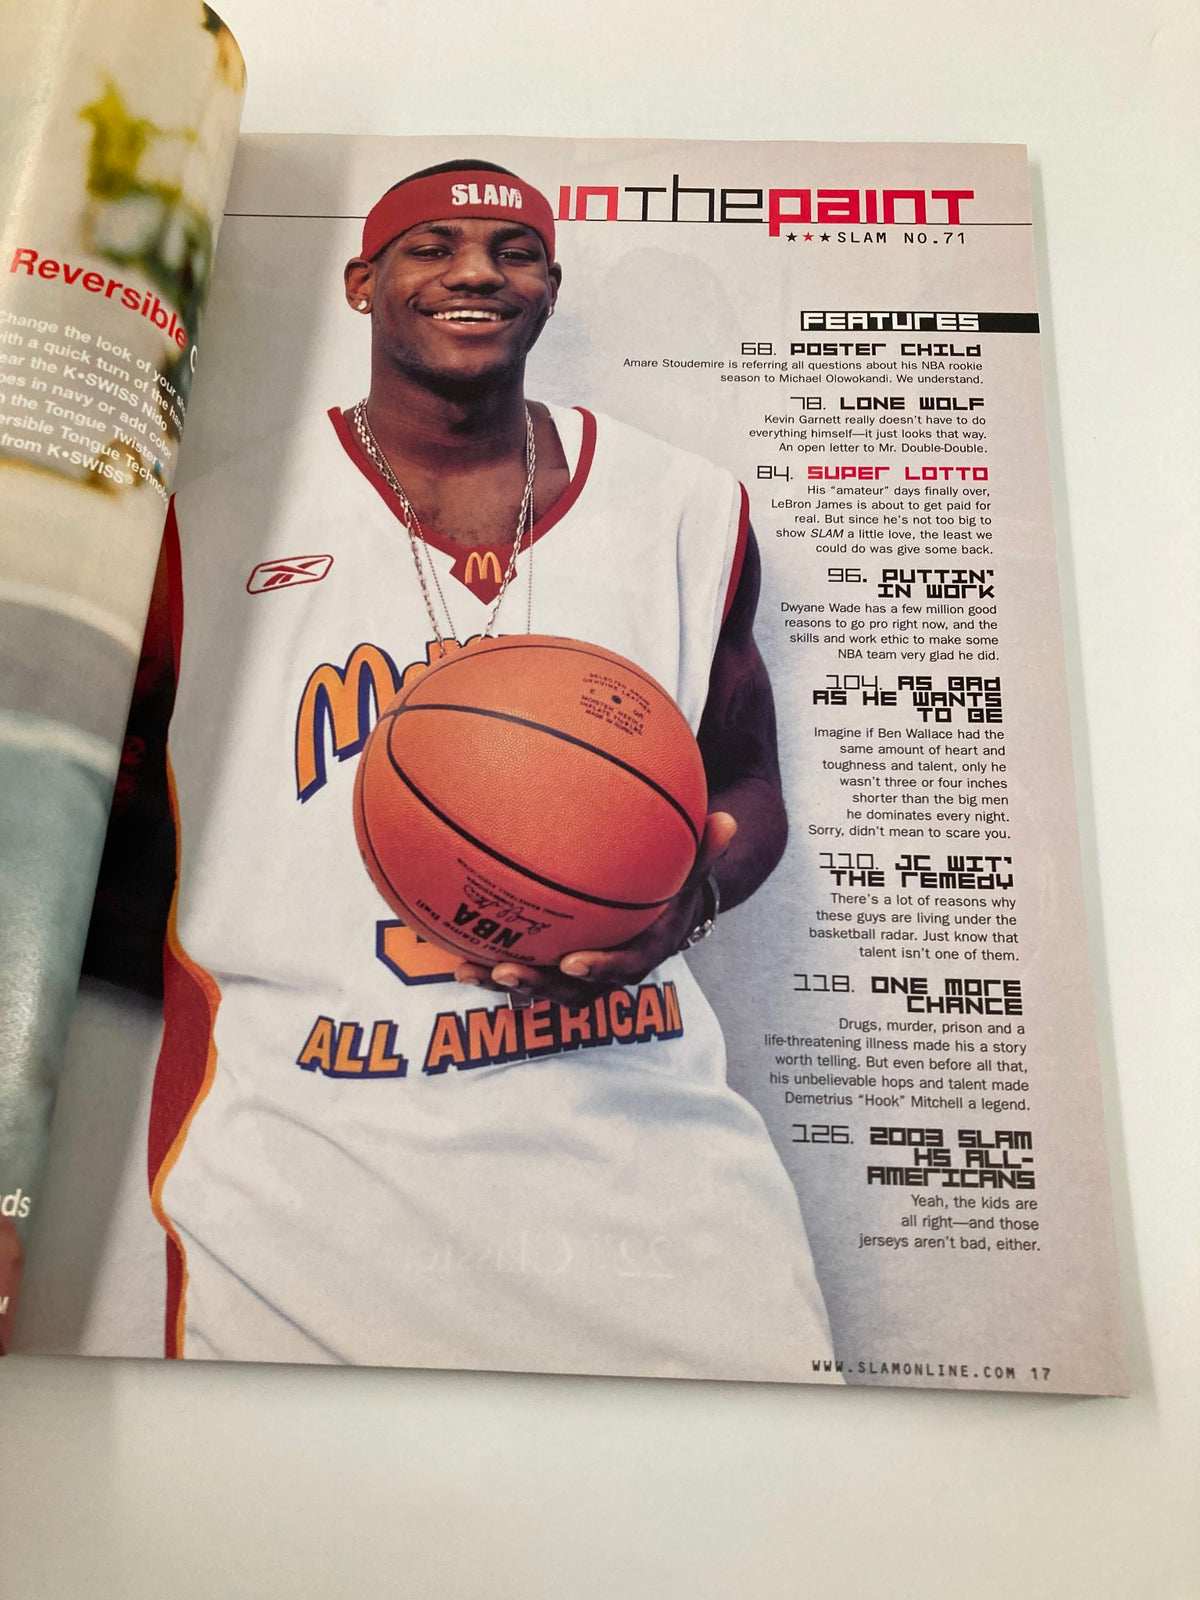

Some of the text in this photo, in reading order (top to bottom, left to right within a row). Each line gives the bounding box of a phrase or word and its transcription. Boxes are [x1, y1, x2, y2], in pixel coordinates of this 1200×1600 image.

[451, 183, 523, 210] SLAM
[837, 232, 965, 244] SLAM NO.71
[9, 248, 188, 350] Reversible
[741, 342, 776, 355] 68.
[64, 325, 91, 344] the
[96, 336, 132, 362] look
[136, 358, 152, 374] of
[153, 370, 176, 397] your
[623, 358, 982, 371] Amare Stoudemire is referring all questions about his NBA rookie
[28, 338, 38, 349] a
[44, 341, 91, 364] quick
[97, 357, 130, 382] turn
[134, 377, 149, 393] of
[151, 387, 168, 411] the
[30, 356, 57, 374] the
[141, 401, 167, 432] Nido
[790, 397, 984, 410] 78. LONE WOLF
[11, 394, 38, 410] the
[45, 400, 106, 432] Tongue
[31, 377, 47, 392] in
[52, 384, 94, 407] navy
[98, 402, 116, 415] or
[119, 411, 147, 435] add
[149, 432, 172, 460] color
[1, 432, 41, 453] from
[61, 425, 120, 460] Tongue
[779, 443, 987, 453] An open letter to Mr. Double-Double.
[757, 465, 793, 482] 84.
[905, 467, 988, 481] LOTTO
[772, 499, 991, 512] LeBron James is about to get paid for
[828, 568, 867, 583] 96.
[878, 584, 911, 598] IN
[781, 602, 824, 614] Dwyane
[829, 603, 860, 613] Wade
[865, 603, 886, 613] has
[901, 604, 922, 614] few
[926, 604, 964, 614] million
[968, 605, 996, 616] good
[838, 649, 999, 662] NBA team very glad he did.
[826, 675, 882, 692] 104.
[898, 676, 932, 691] AS
[813, 690, 1002, 707] AS HE WANTS
[917, 708, 1003, 723] TO BE
[815, 727, 1004, 739] Imagine if Ben Wallace had the
[809, 824, 1010, 840] Sorry, didn't mean to scare you.
[819, 853, 879, 870] 110.
[895, 854, 931, 871] JC
[830, 870, 885, 887] THE
[452, 902, 523, 949] NBA
[794, 973, 855, 992] 118.
[871, 976, 928, 995] ONE
[906, 995, 1023, 1016] CHANCE
[422, 980, 684, 1076] AMERICAN
[296, 1014, 408, 1079] ALL
[765, 1034, 1026, 1056] life-threatening illness made his a story
[785, 1092, 853, 1105] Demetrius
[911, 1096, 963, 1109] Mitchell
[968, 1100, 976, 1109] a
[982, 1098, 1030, 1113] legend.
[792, 1124, 1032, 1150] 126. 2003 SLAM
[914, 1148, 1033, 1169] HS ALL-
[911, 1194, 1037, 1210] Yeah, the kids are
[858, 1233, 1040, 1251] jerseys aren't bad, either.
[812, 1360, 1050, 1380] WWW.SLAMONLINE.COM 17
